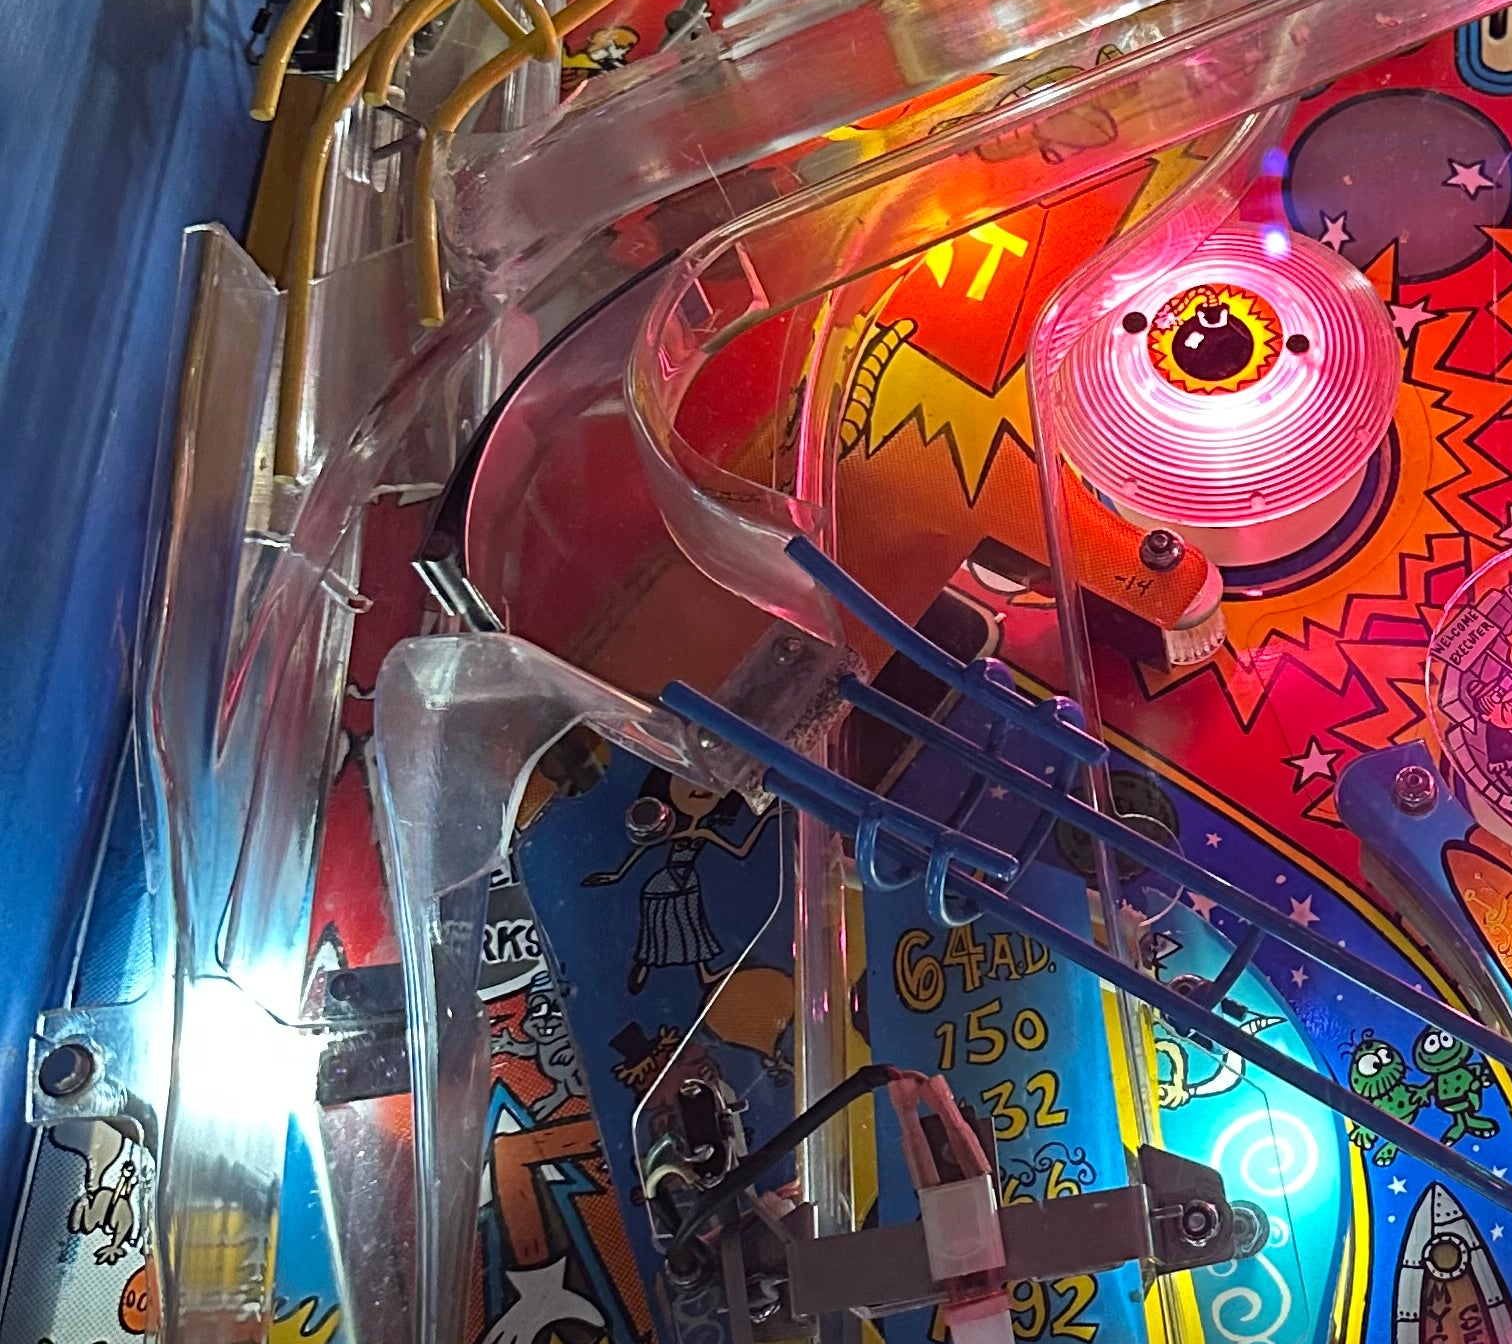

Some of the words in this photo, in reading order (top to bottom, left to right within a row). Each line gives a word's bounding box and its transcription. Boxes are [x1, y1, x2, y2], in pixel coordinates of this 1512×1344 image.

[1434, 609, 1479, 655] WELCOME
[1451, 620, 1495, 667] EXECUTER
[894, 921, 987, 1014] 64
[935, 998, 1048, 1071] 150
